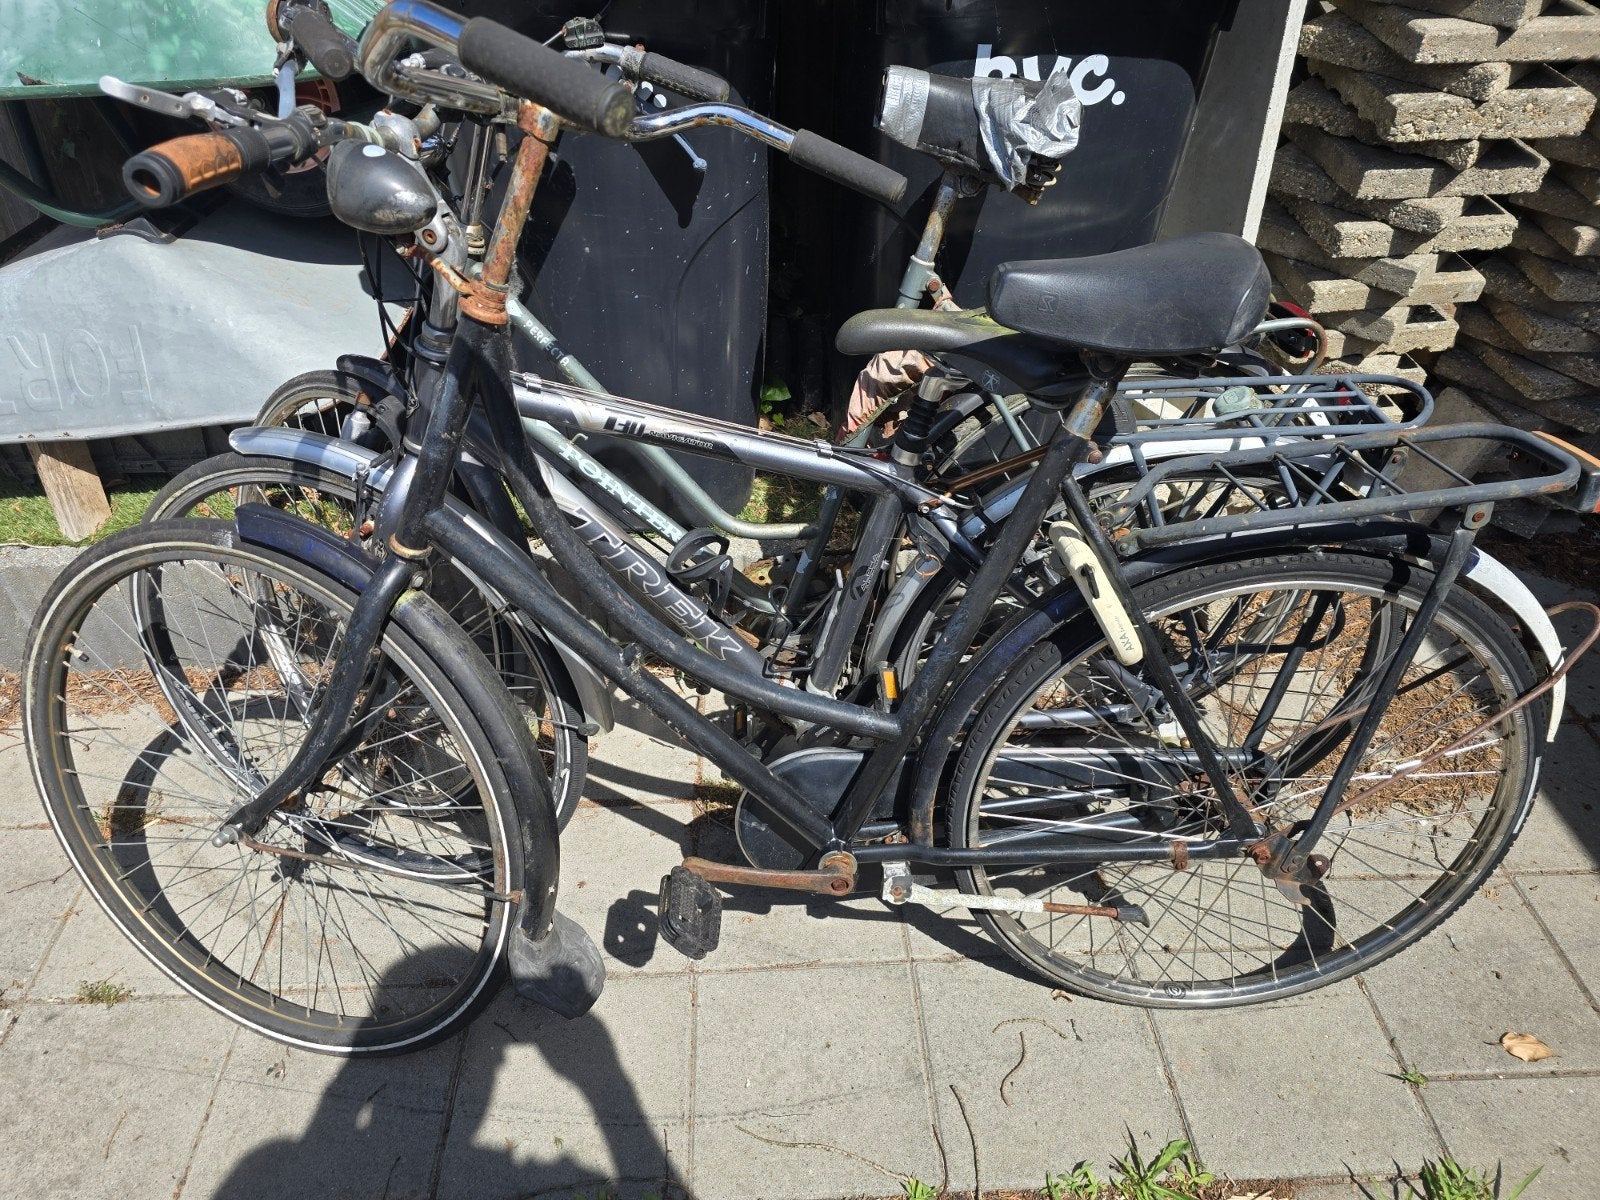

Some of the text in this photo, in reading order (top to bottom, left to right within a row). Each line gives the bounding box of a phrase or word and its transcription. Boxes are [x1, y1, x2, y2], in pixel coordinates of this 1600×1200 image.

[0, 325, 153, 416] FOR
[523, 319, 570, 367] PERFECTA
[559, 443, 688, 543] POINTER
[571, 507, 743, 661] TREK
[1119, 632, 1135, 651] AXA
